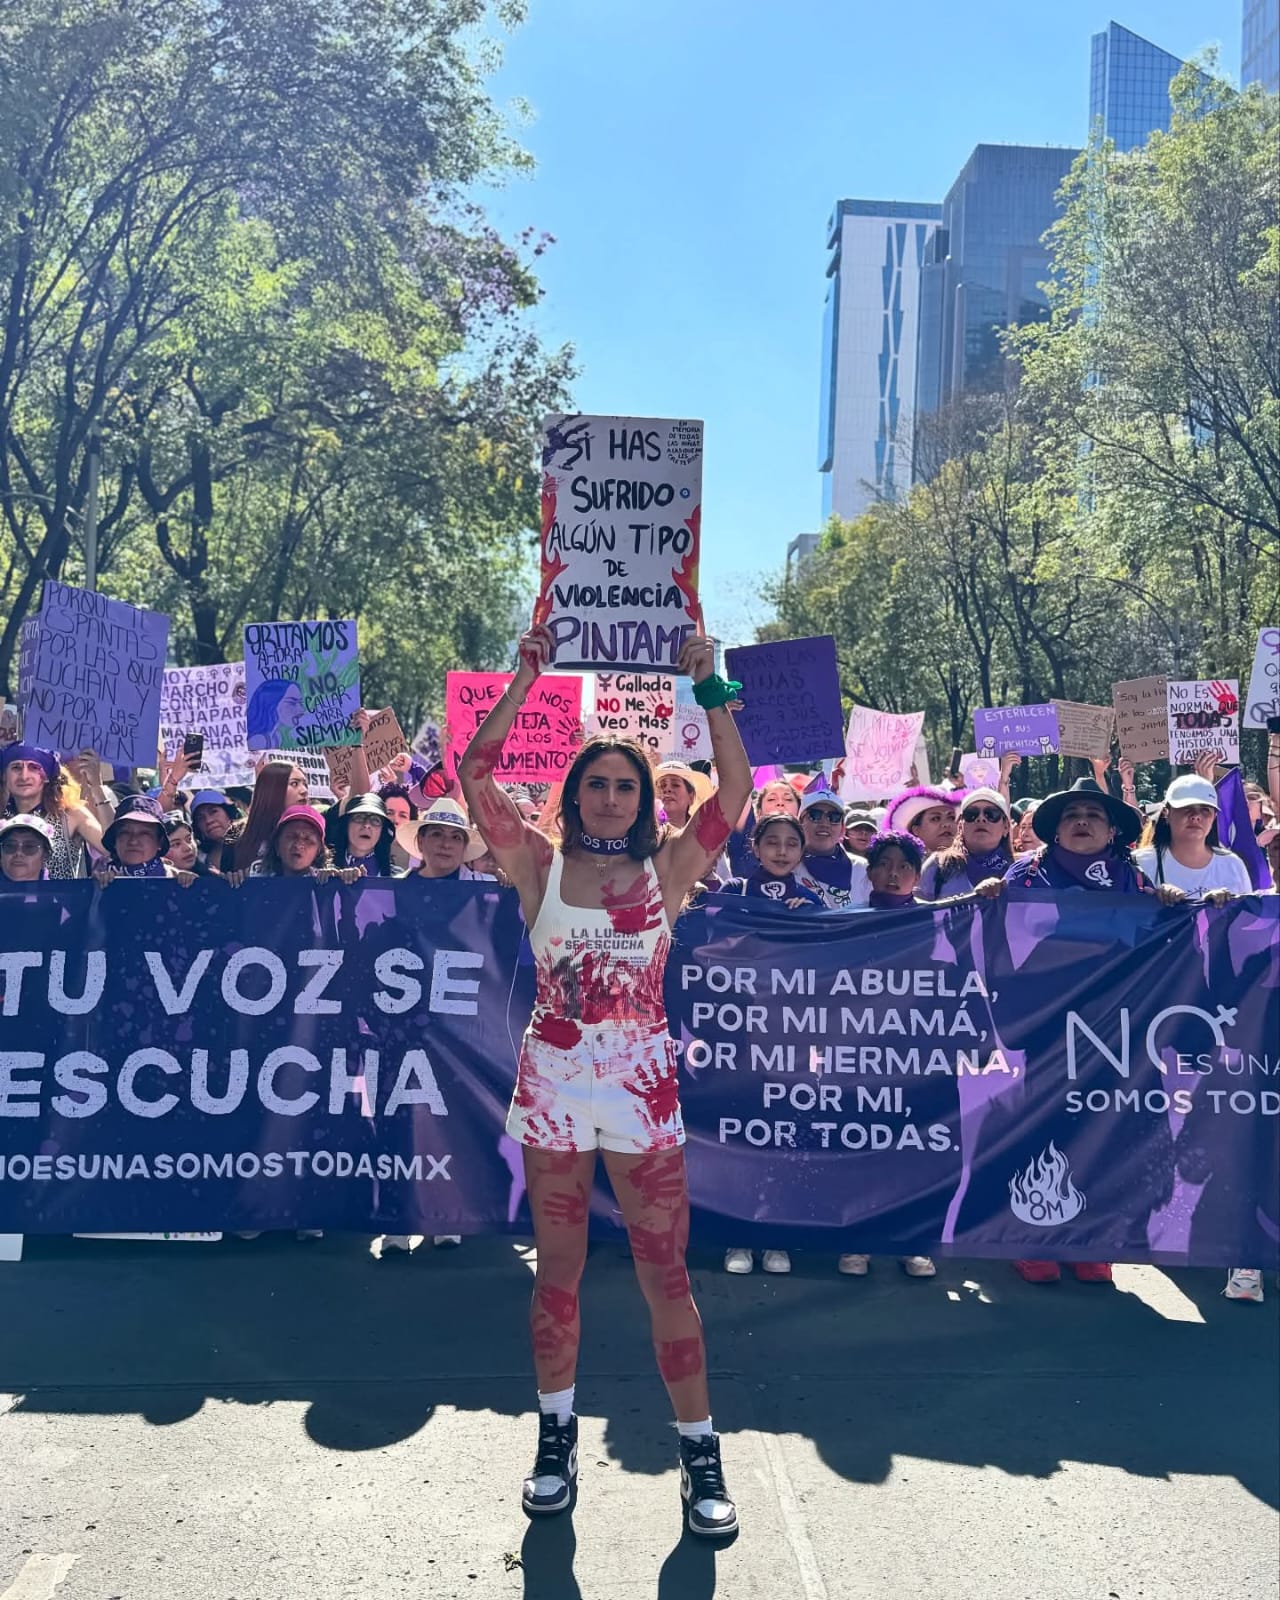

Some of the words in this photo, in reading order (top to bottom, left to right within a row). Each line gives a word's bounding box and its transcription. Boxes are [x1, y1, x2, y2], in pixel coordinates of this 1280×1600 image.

[609, 428, 662, 462] HAS
[571, 475, 675, 513] SUFRIDO
[549, 519, 616, 553] ALGÚN
[603, 559, 629, 577] DE
[39, 629, 78, 662] POR
[85, 643, 120, 675] LAS
[261, 664, 299, 681] PARA
[308, 672, 337, 696] NO
[615, 674, 672, 693] Callada
[36, 655, 117, 705] LUCHAN
[135, 685, 149, 717] Y
[161, 681, 229, 699] MARCHO
[1170, 685, 1188, 700] No
[1195, 684, 1209, 698] Es
[29, 687, 55, 714] NO
[58, 692, 98, 723] POR
[110, 707, 140, 728] LAS
[160, 698, 194, 712] CON
[197, 695, 219, 710] MI
[459, 685, 497, 707] QUE
[539, 691, 573, 714] NOS
[596, 698, 620, 713] NO
[625, 697, 645, 711] Me
[1170, 702, 1213, 713] NORMAL
[1218, 701, 1239, 713] QUE
[110, 719, 140, 740] QUE
[597, 715, 629, 730] Veo
[1171, 711, 1232, 729] TODAS
[164, 734, 244, 752] MACHAR
[526, 733, 552, 744] LOS
[1169, 729, 1214, 739] TENGAMOS
[1220, 730, 1238, 738] UNA
[1178, 738, 1223, 749] HISTORIA
[571, 927, 589, 938] LA
[585, 940, 644, 950] ESCUCHA
[0, 950, 107, 1016] TU
[144, 946, 345, 1016] VOZ
[373, 948, 485, 1016] SE
[682, 964, 757, 995] POR
[771, 968, 816, 996] MI
[829, 968, 999, 1003] ABUELA,
[692, 1002, 768, 1033] POR
[782, 1006, 828, 1035] MI
[841, 1001, 988, 1042] MAMÁ,
[750, 1044, 795, 1072] MI
[809, 1044, 1020, 1078] HERMANA,
[1177, 1053, 1213, 1076] ES
[0, 1045, 449, 1119] ESCUCHA
[763, 1082, 842, 1113] POR
[857, 1086, 912, 1118] MI,
[1065, 1089, 1194, 1114] SOMOS
[719, 1118, 797, 1148] POR
[811, 1121, 960, 1151] TODAS.
[0, 1150, 452, 1181] OESUNASOMOSTODASMX
[1029, 1190, 1064, 1221] 8M
